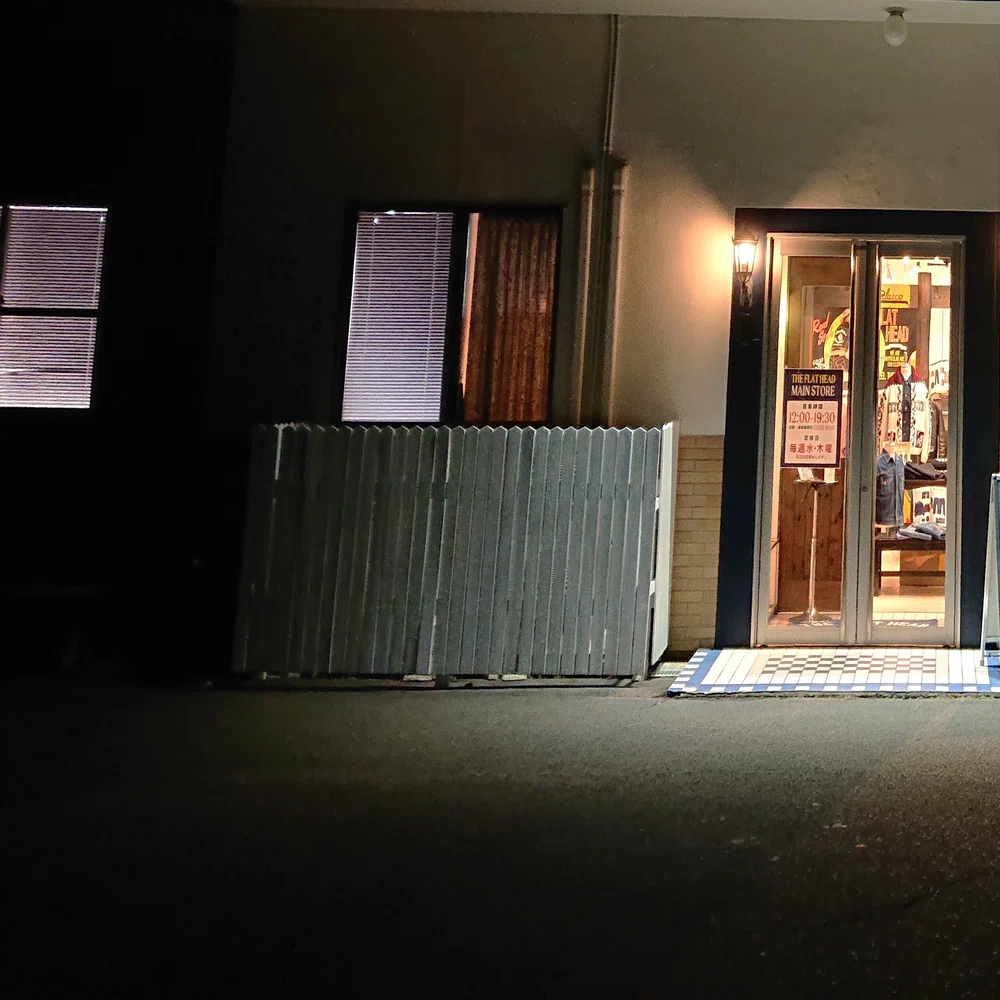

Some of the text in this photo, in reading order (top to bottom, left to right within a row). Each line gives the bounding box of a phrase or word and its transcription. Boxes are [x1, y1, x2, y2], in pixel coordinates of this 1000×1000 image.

[881, 309, 899, 326] LAT
[885, 325, 910, 343] HEAD
[791, 373, 837, 384] THE FLAT HEAD
[791, 385, 835, 397] MAIN STORE
